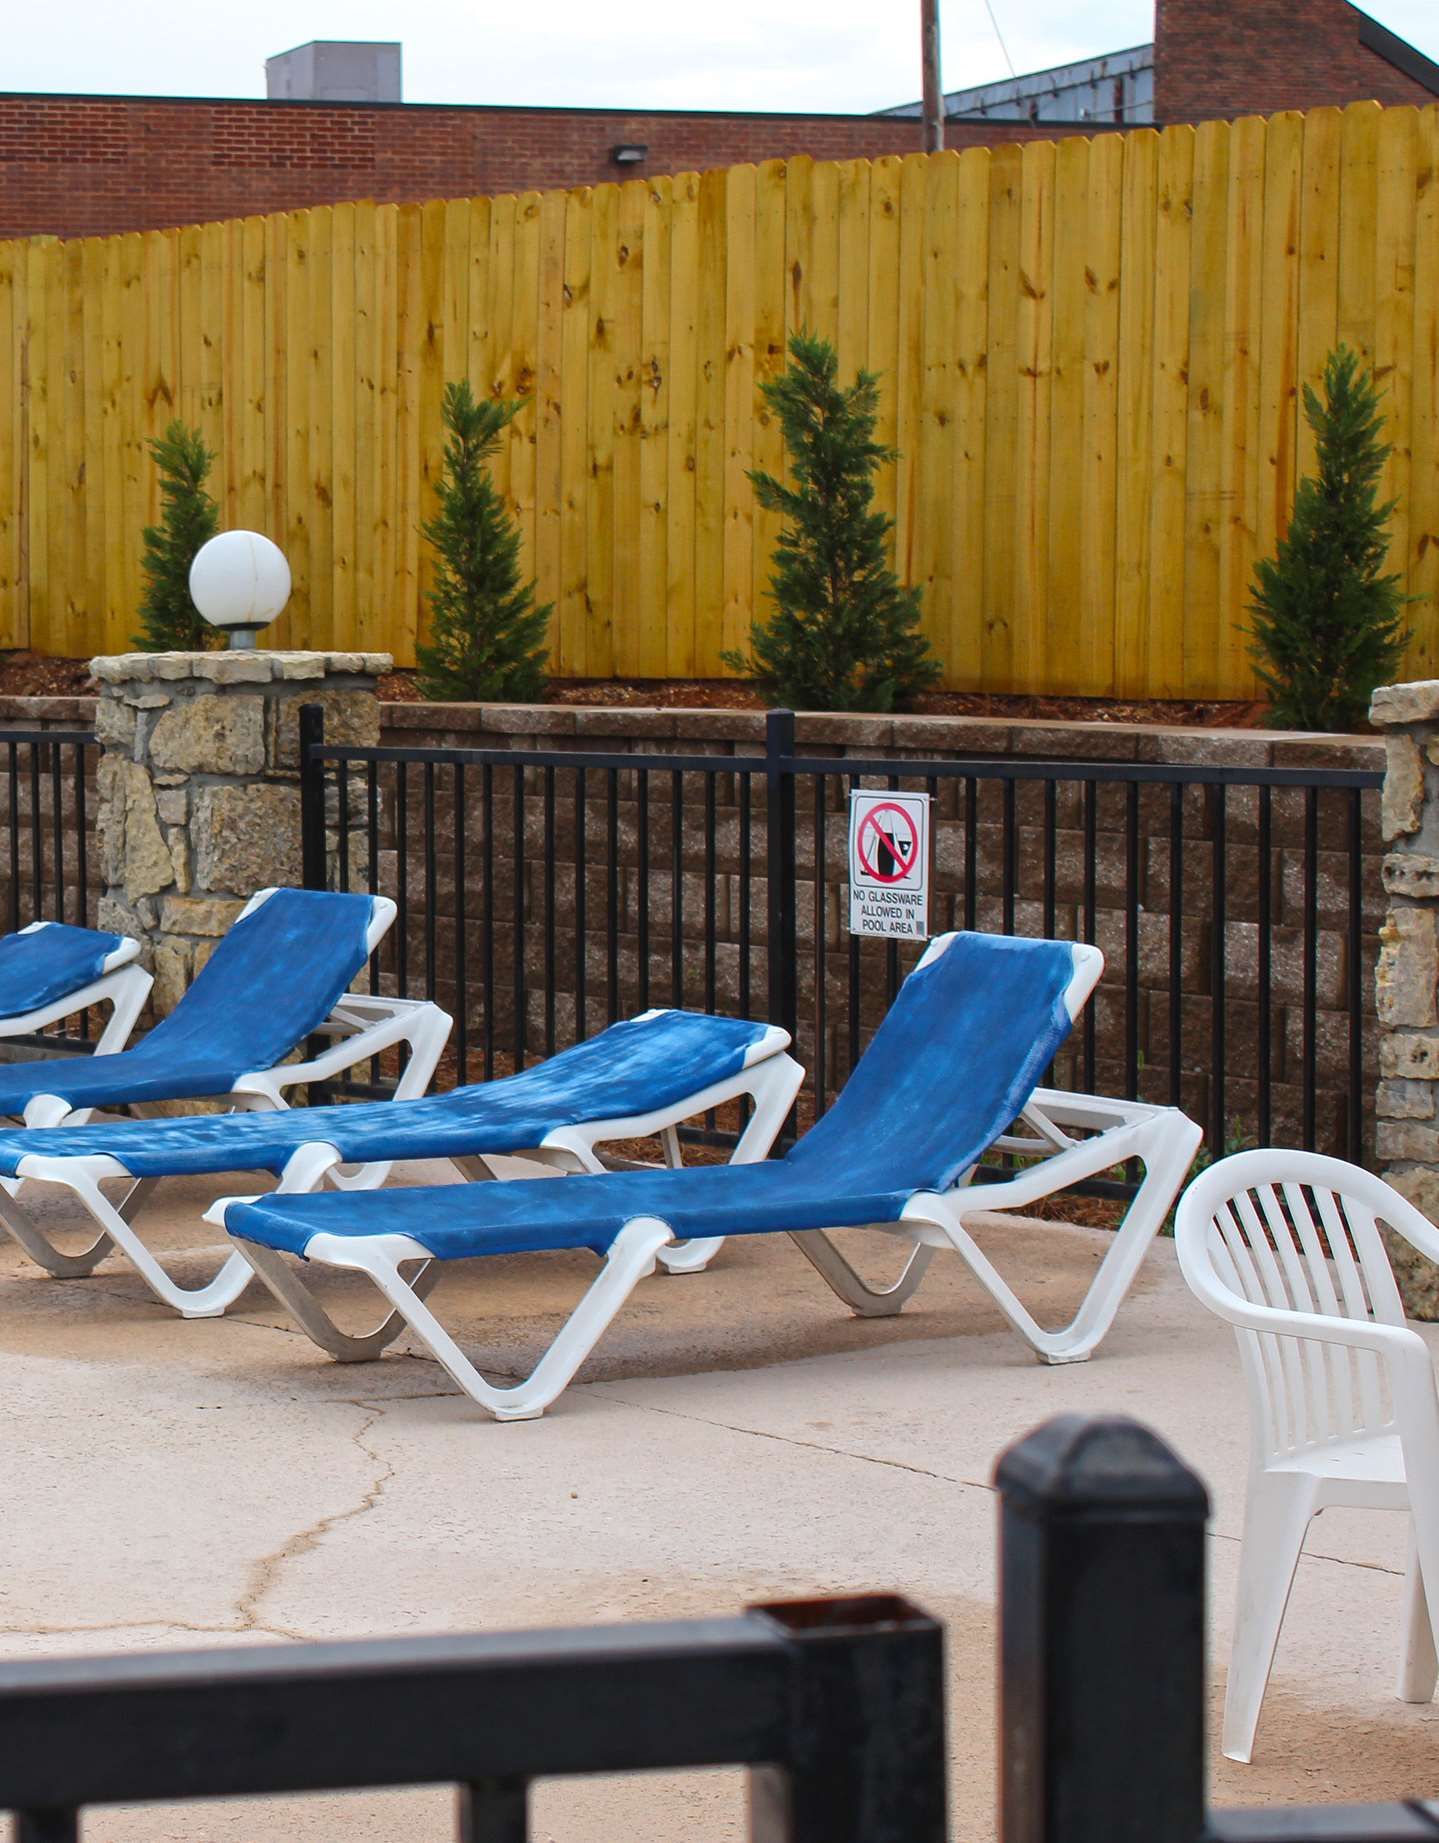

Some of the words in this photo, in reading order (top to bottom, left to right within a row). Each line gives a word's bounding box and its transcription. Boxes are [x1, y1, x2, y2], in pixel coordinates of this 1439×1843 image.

[853, 889, 865, 901] NO
[868, 890, 923, 906] GLASSWARE
[861, 905, 902, 919] ALLOWED
[906, 908, 915, 920] IN
[862, 919, 886, 932] POOL
[889, 922, 913, 935] AREA
